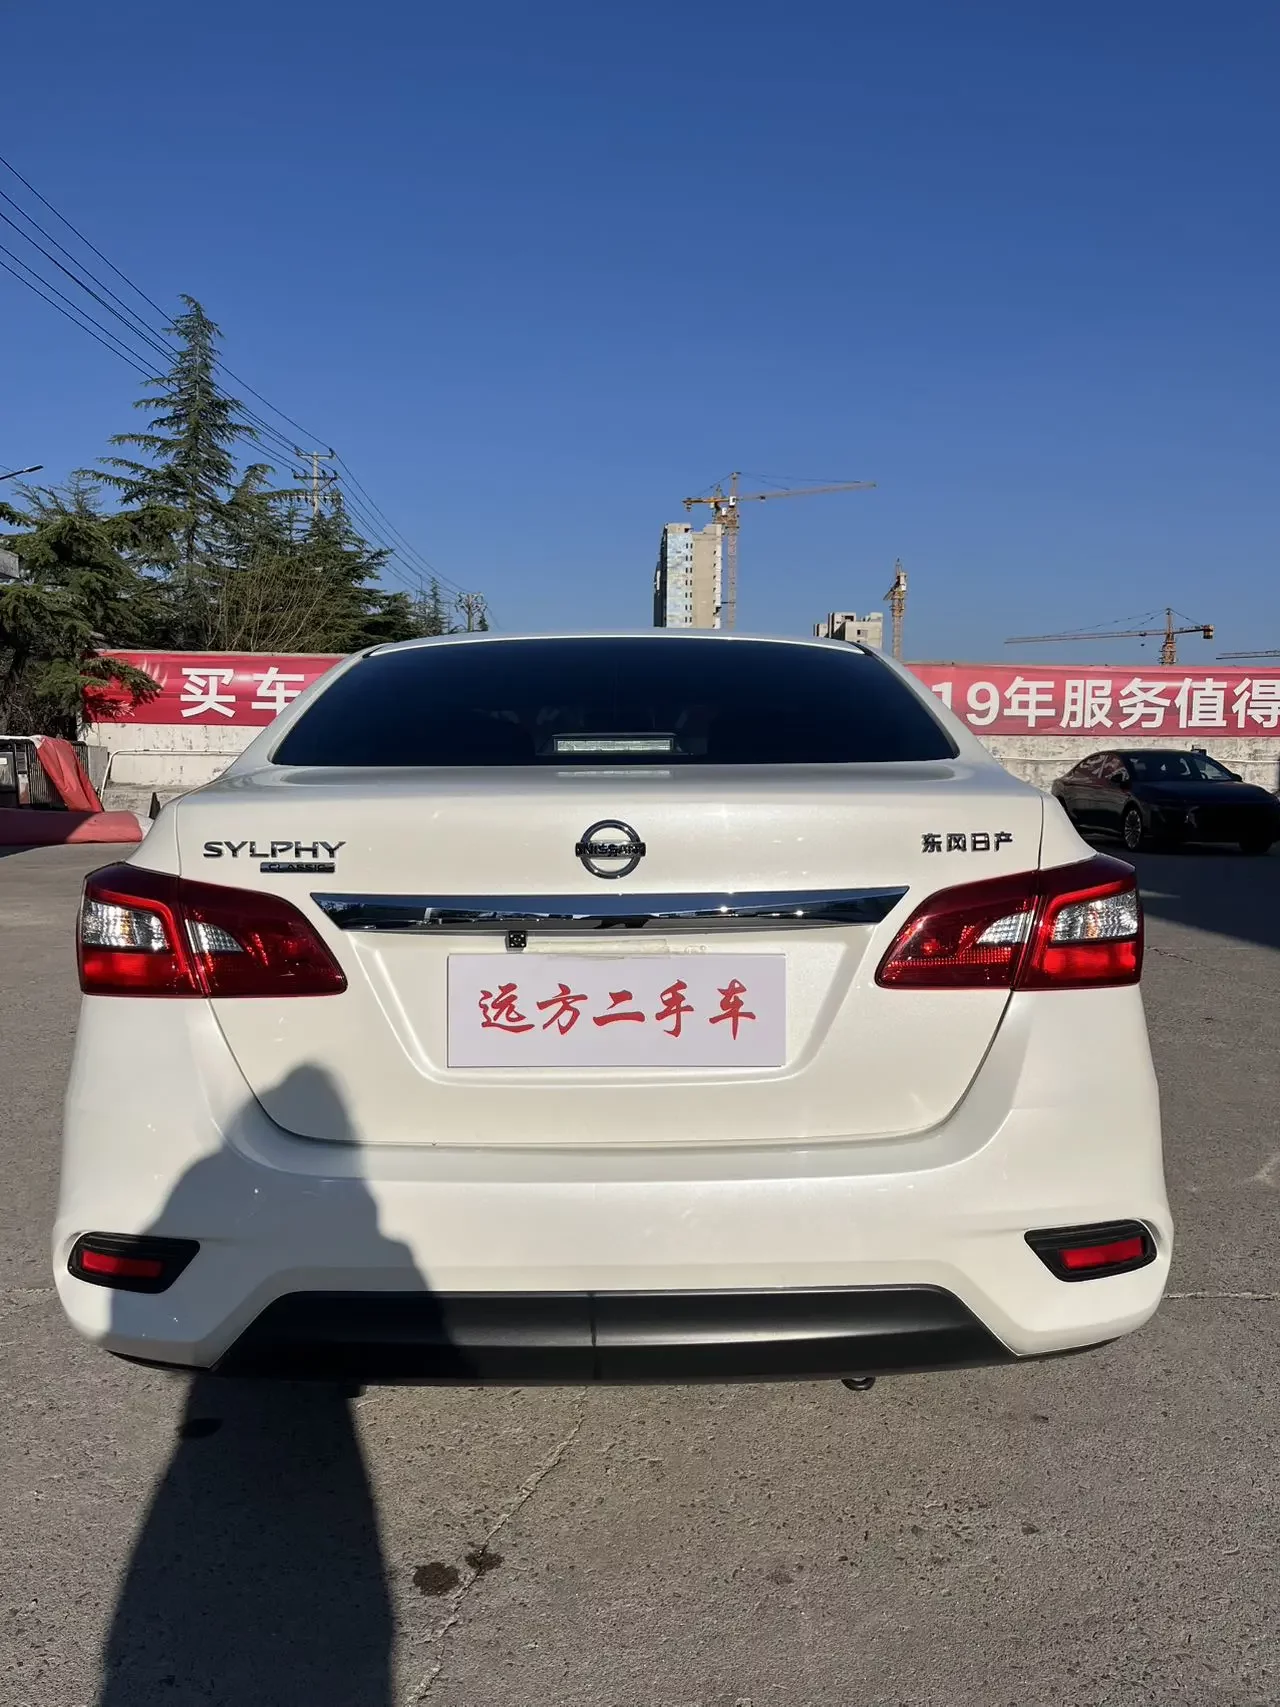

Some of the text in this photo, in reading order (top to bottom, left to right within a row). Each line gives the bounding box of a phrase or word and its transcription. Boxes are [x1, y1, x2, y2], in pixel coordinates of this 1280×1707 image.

[180, 666, 305, 718] 买车
[931, 675, 1280, 729] 19年服务值得
[203, 840, 346, 859] SYLPHY
[580, 842, 641, 857] NISSAN
[921, 831, 1014, 853] 东风日产
[266, 863, 328, 872] CLASSIC
[478, 978, 757, 1040] 远方二手车
